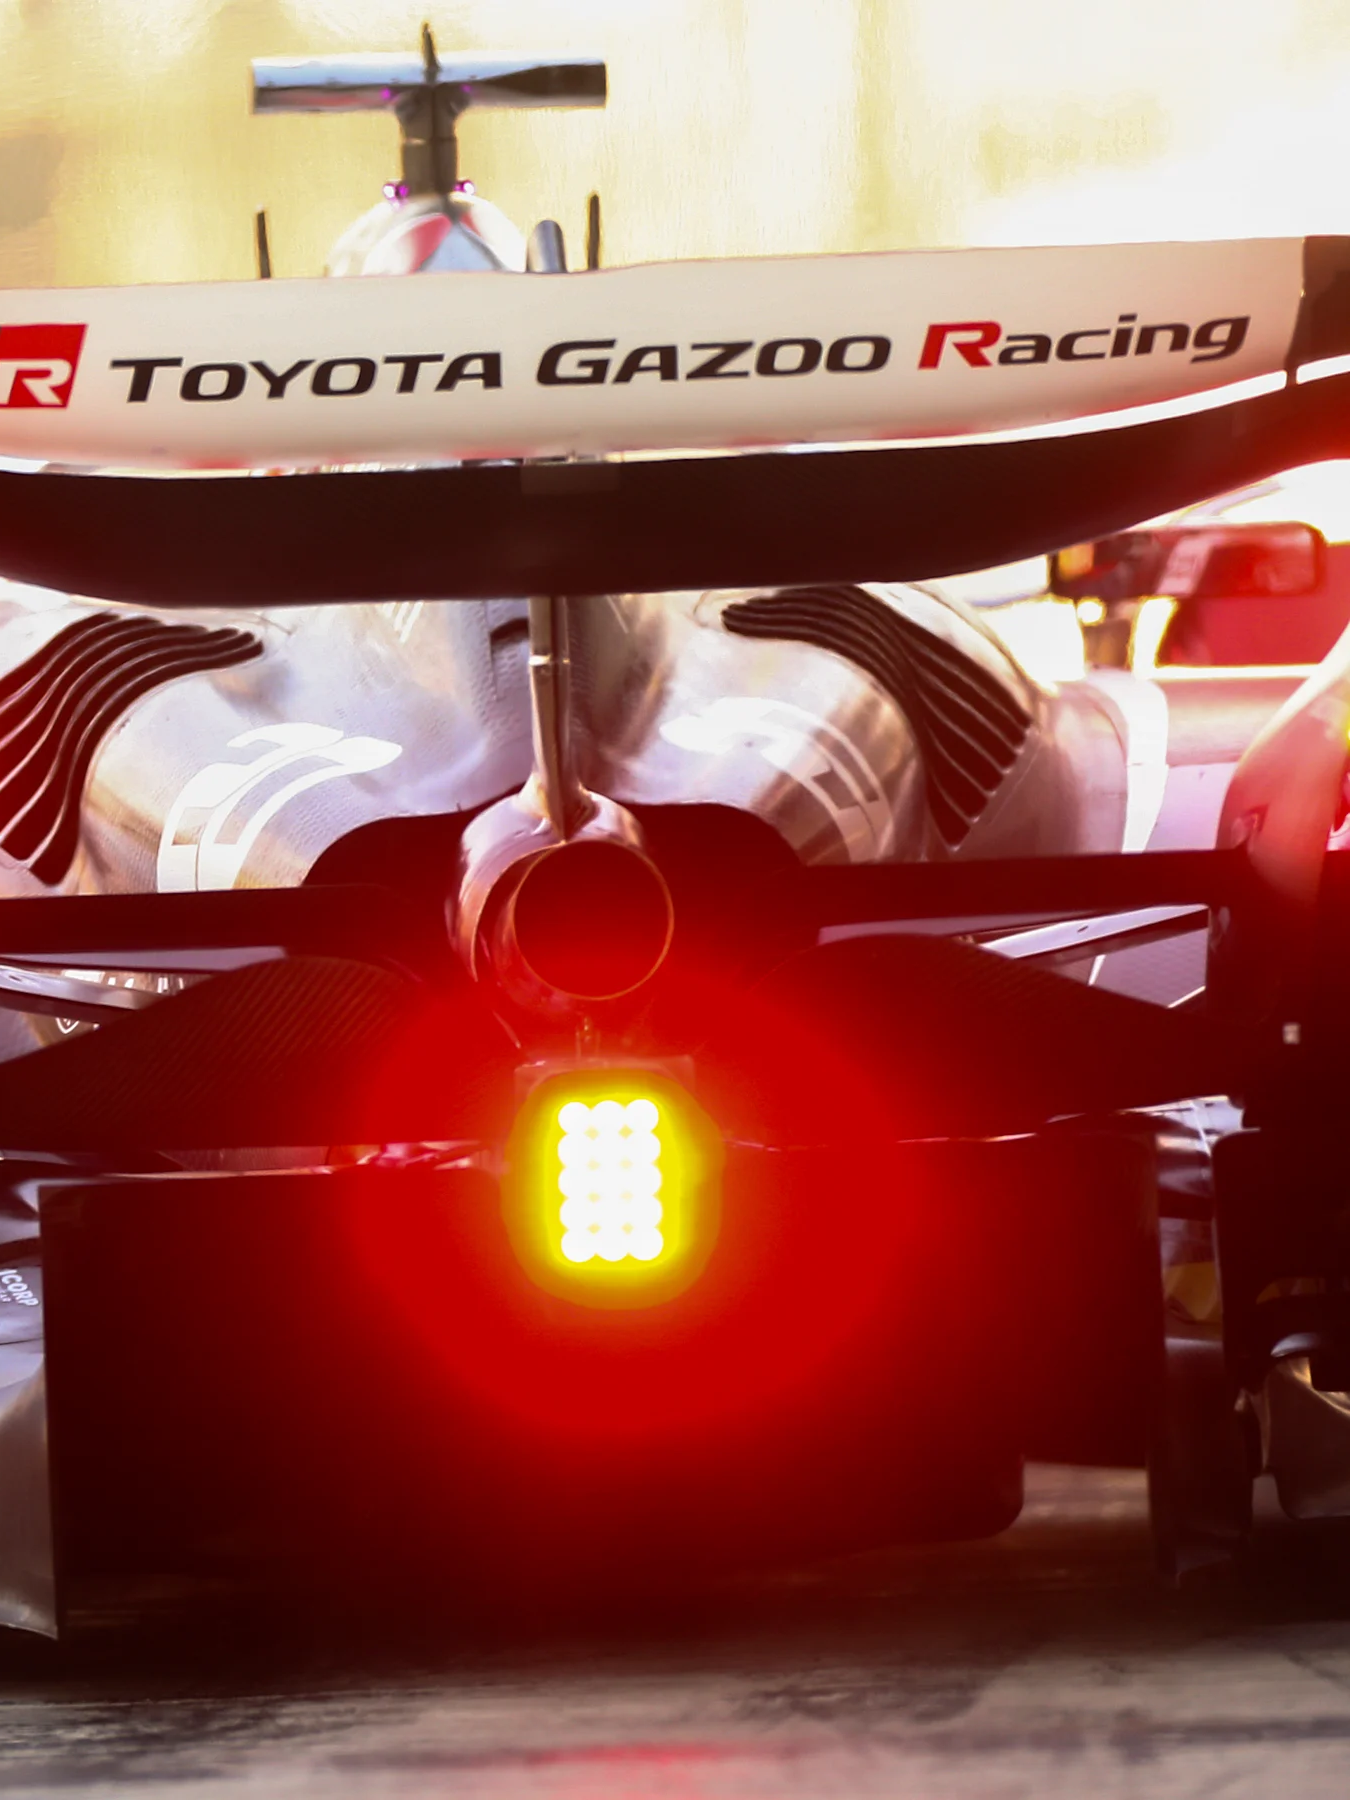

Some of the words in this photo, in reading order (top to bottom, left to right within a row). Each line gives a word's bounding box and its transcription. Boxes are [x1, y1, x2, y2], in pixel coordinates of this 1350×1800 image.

[109, 351, 503, 404] TOYOTA
[535, 334, 893, 387] GAZOO
[916, 312, 1251, 370] Racing
